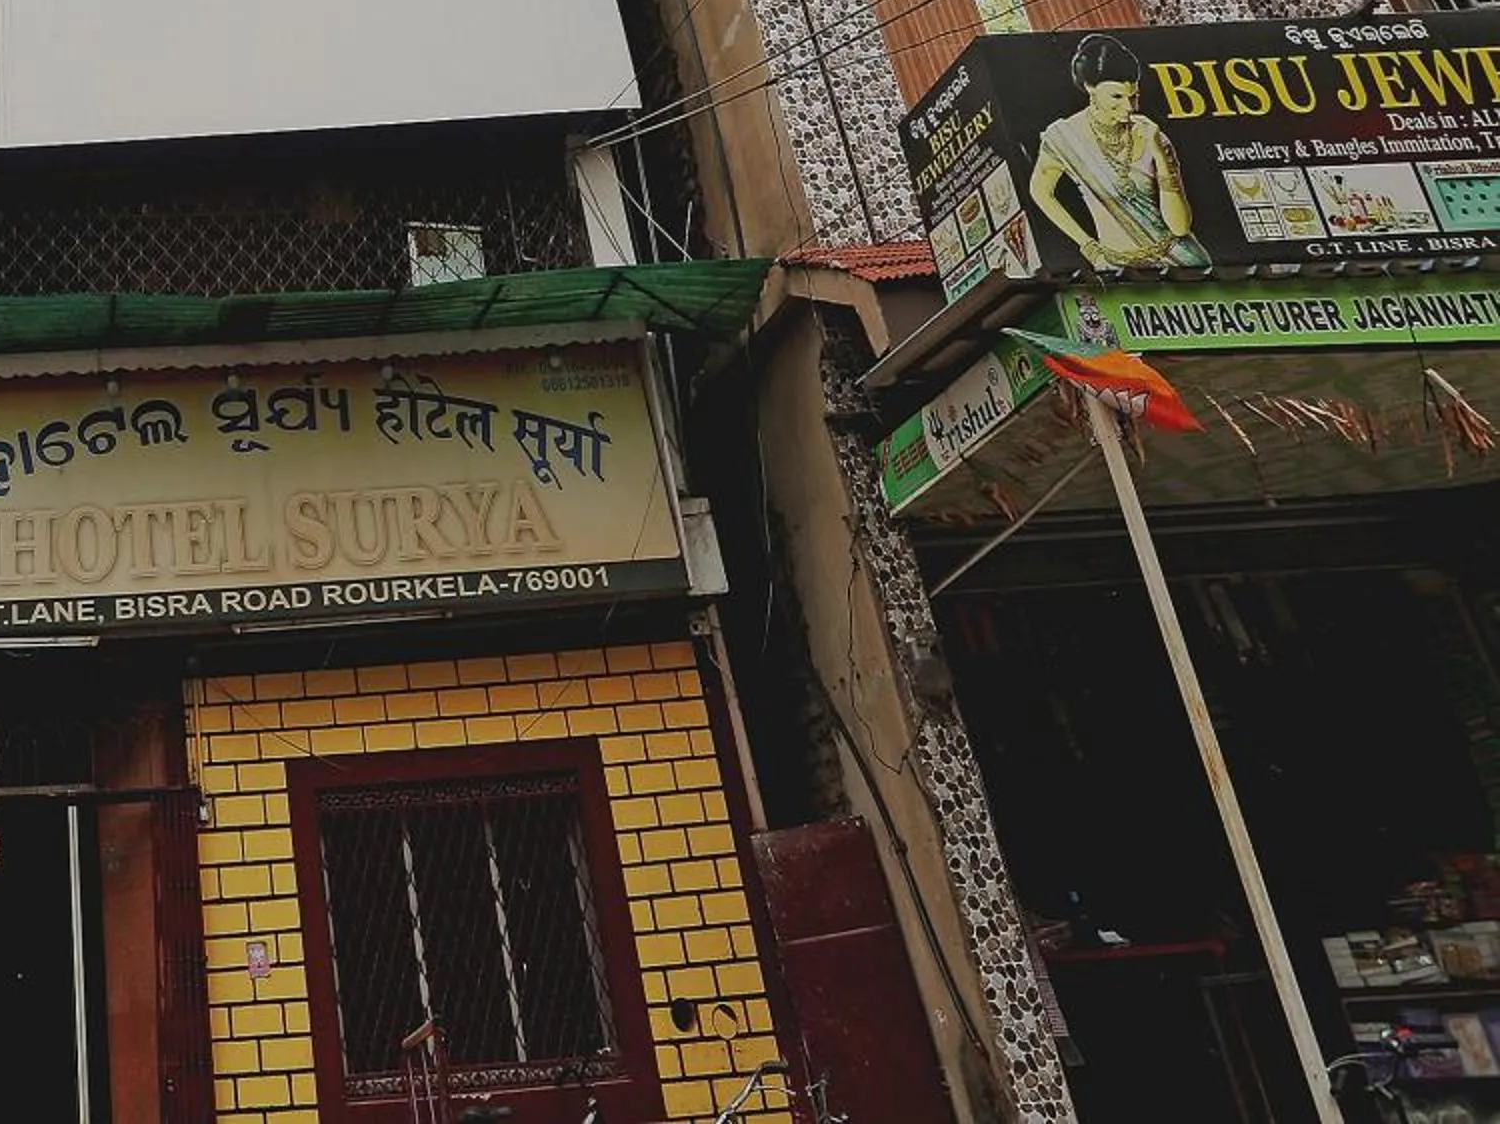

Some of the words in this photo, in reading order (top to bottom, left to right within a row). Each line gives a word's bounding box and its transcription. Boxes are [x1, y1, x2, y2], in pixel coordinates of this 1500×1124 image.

[1148, 55, 1317, 120] BISU
[929, 109, 962, 153] BISU
[1387, 111, 1438, 131] Deals
[1438, 111, 1459, 128] in
[914, 101, 995, 196] JEWELLERY
[1214, 143, 1291, 163] Jewellery
[1294, 139, 1311, 156] &
[1310, 139, 1378, 160] Bangles
[1380, 133, 1481, 156] Immitation,
[1355, 239, 1412, 255] LINE
[1424, 236, 1497, 253] BISRA
[1121, 298, 1348, 339] MANUFACTURER
[510, 410, 612, 490] सूर्या
[284, 479, 563, 571] SURYA
[115, 591, 213, 619] BISRA
[221, 586, 312, 613] ROAD
[322, 566, 610, 606] ROURKELA-769001
